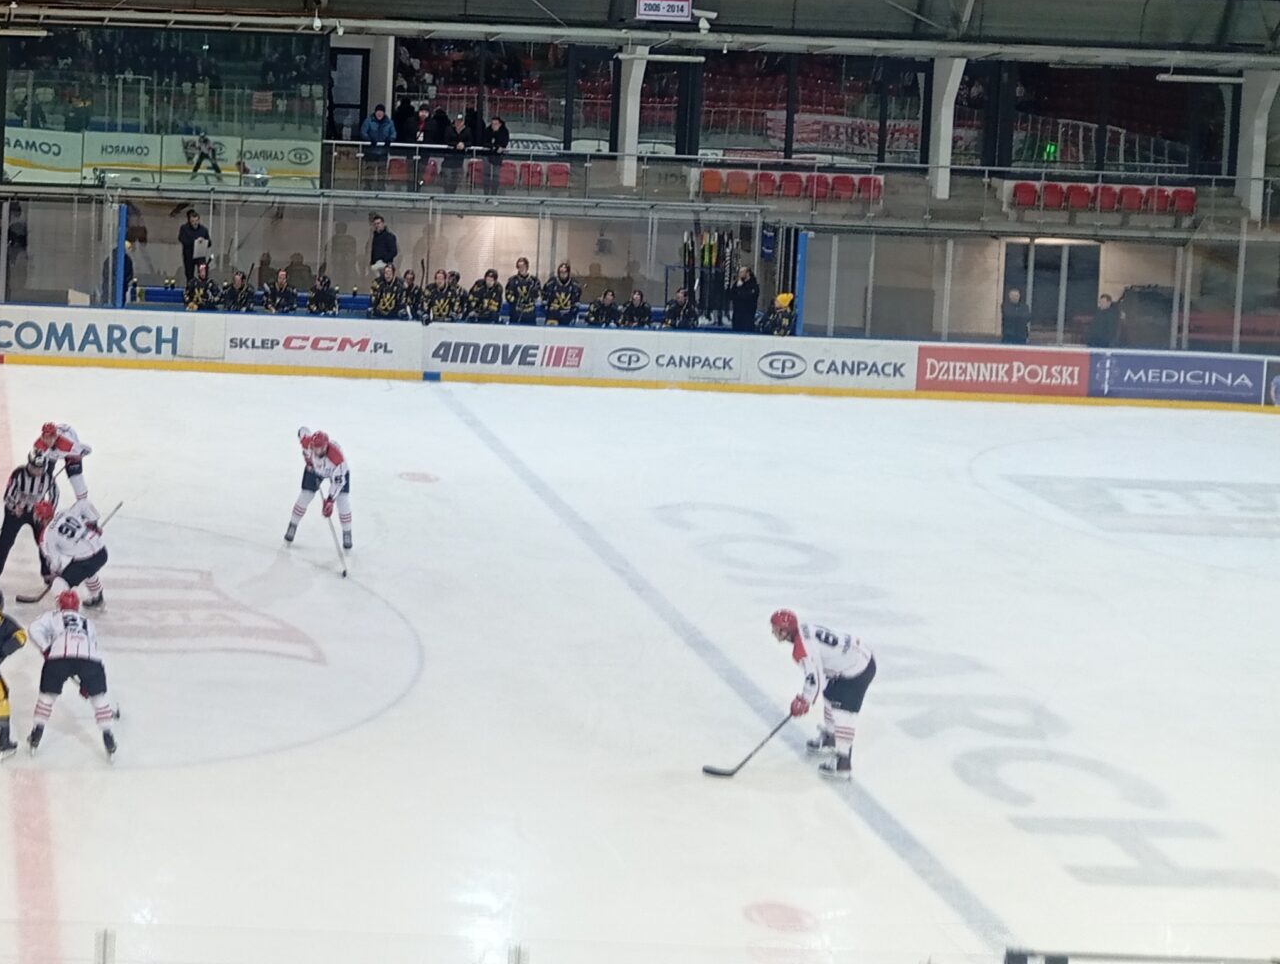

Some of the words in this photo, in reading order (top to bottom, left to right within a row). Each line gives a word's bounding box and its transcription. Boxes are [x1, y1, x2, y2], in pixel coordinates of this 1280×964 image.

[666, 4, 685, 13] 2014
[229, 337, 280, 350] SKLEP
[432, 341, 539, 366] 4MOVE
[655, 354, 733, 371] CANPACK
[813, 359, 906, 378] CANPACK
[925, 358, 1009, 383] DZIENNIK
[1011, 364, 1080, 385] POLSKI
[1124, 368, 1254, 388] MEDICINA
